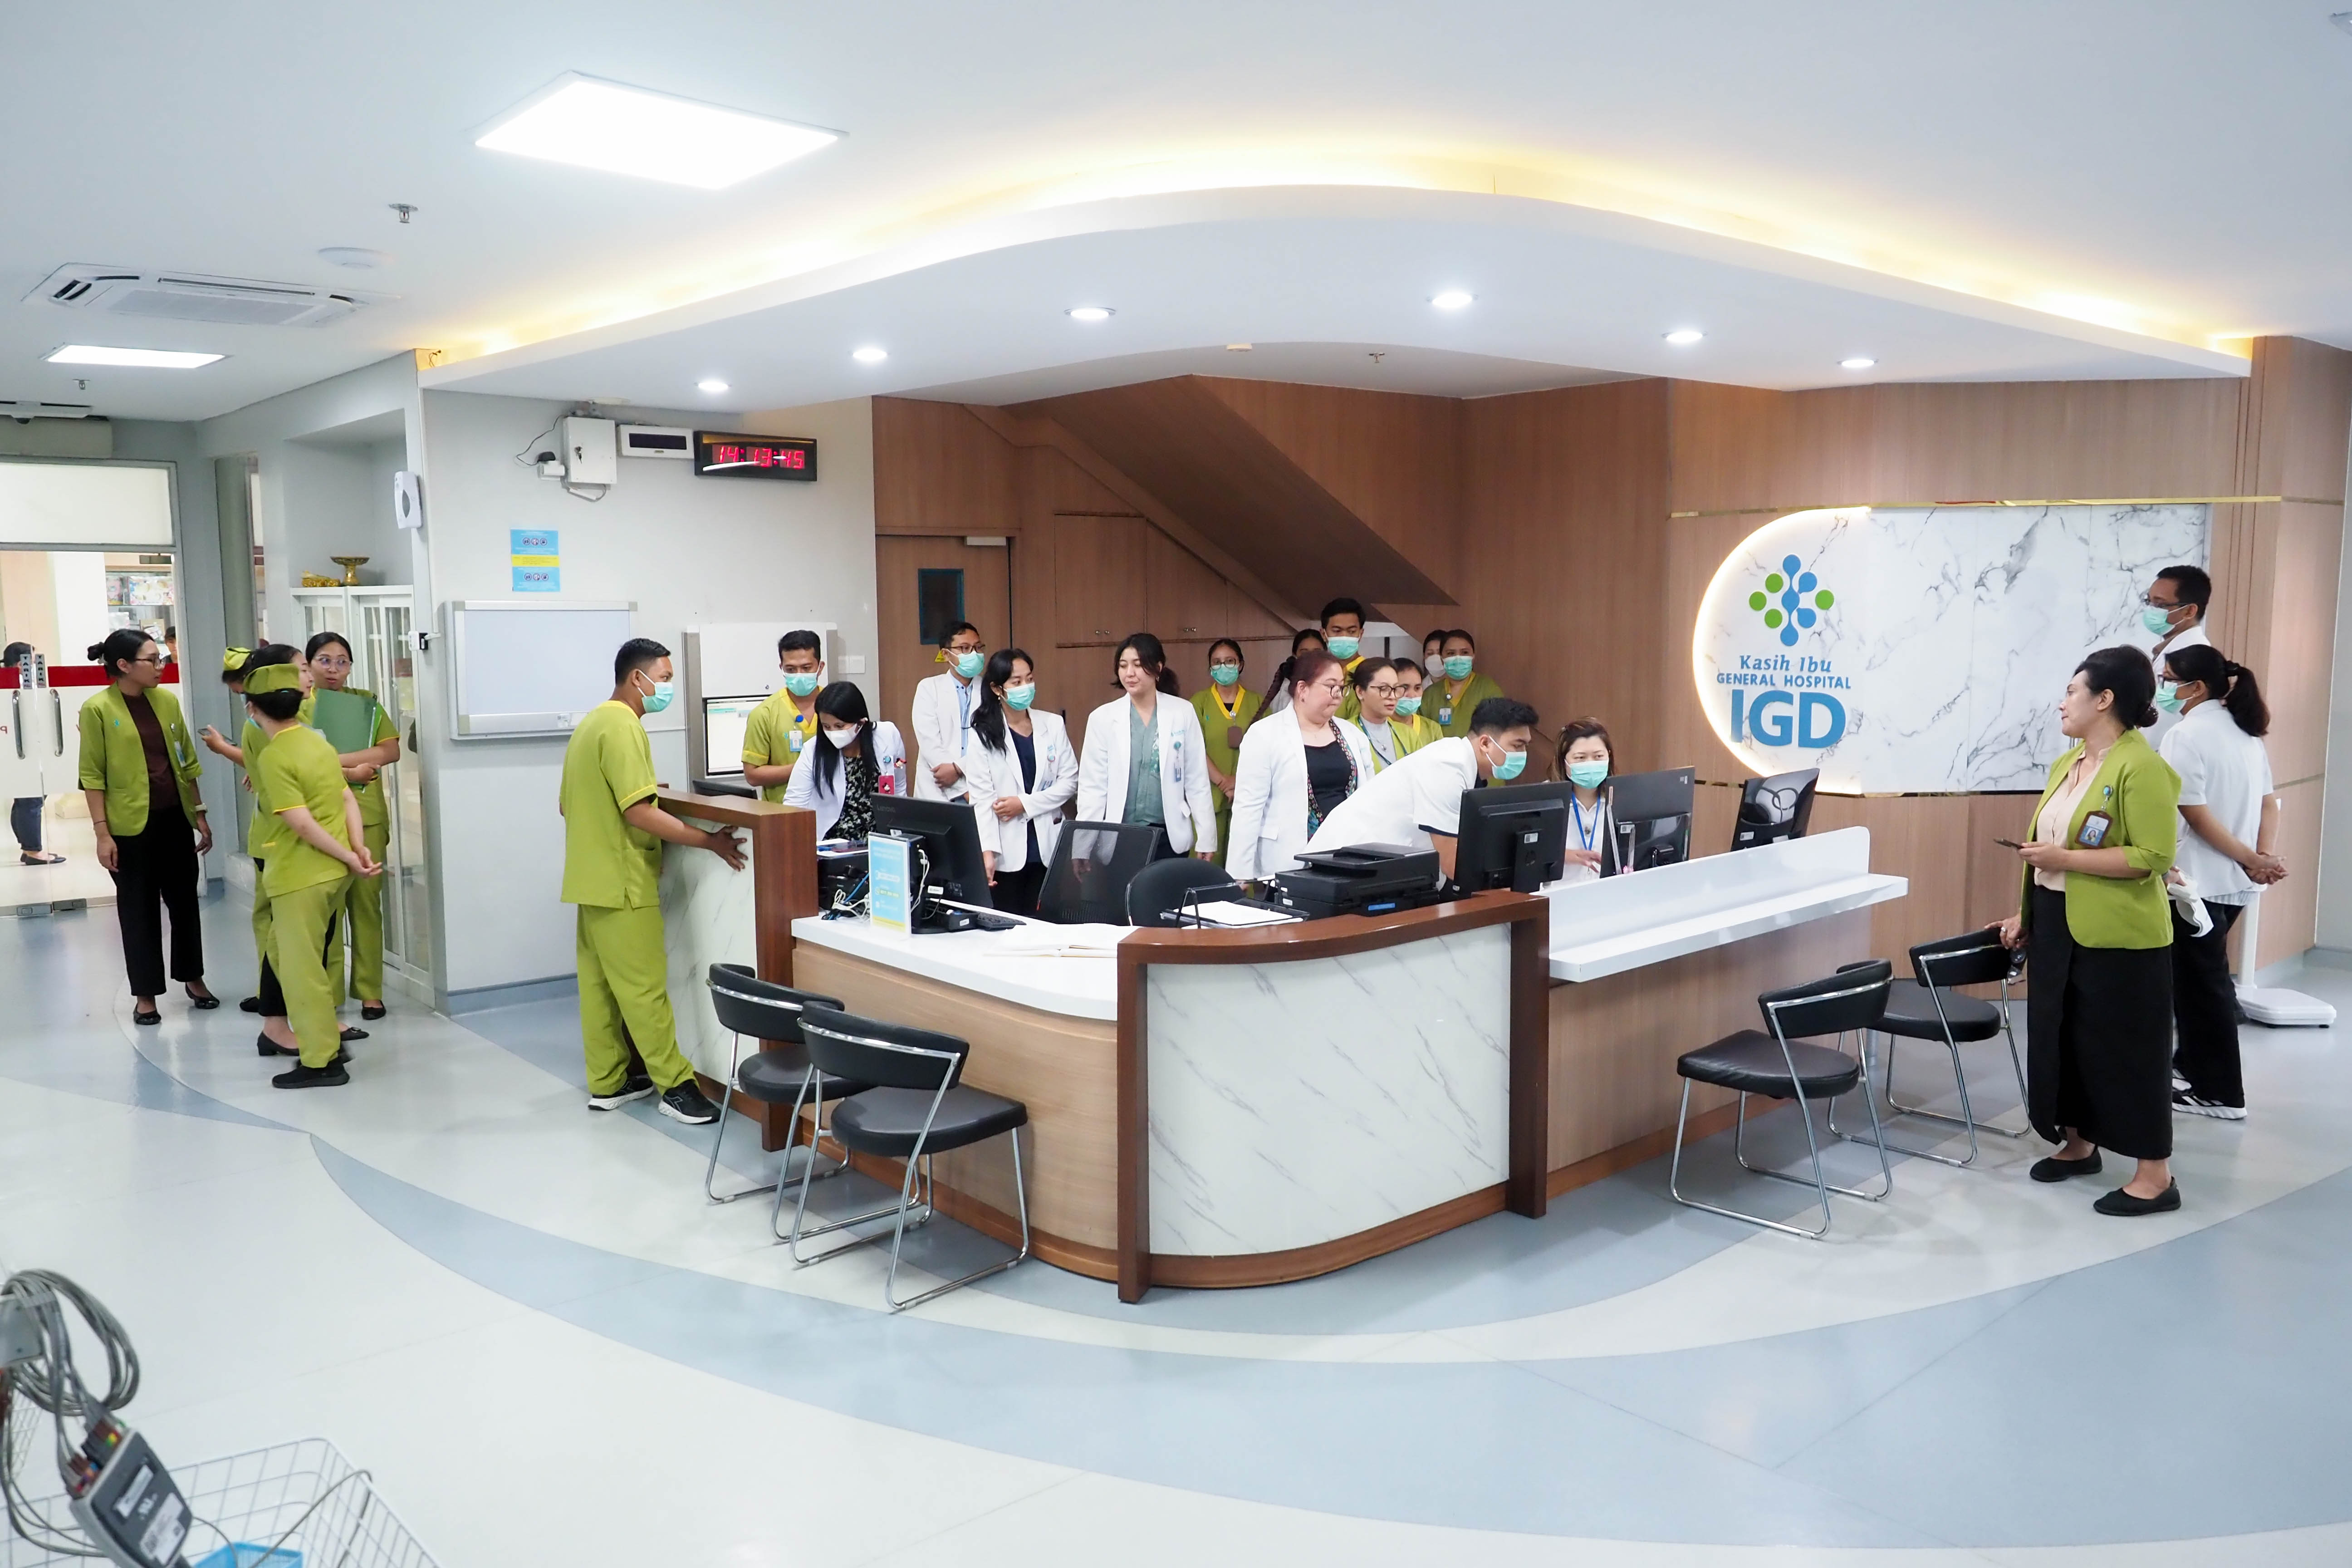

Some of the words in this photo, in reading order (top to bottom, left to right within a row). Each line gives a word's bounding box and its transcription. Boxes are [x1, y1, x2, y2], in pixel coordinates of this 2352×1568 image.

[720, 446, 803, 470] 14:13:45
[1740, 655, 1790, 671] Kasih
[1800, 656, 1832, 672] Ibu
[1717, 673, 1775, 686] GENERAL
[1784, 675, 1851, 689] HOSPITAL
[1731, 689, 1846, 748] IGD
